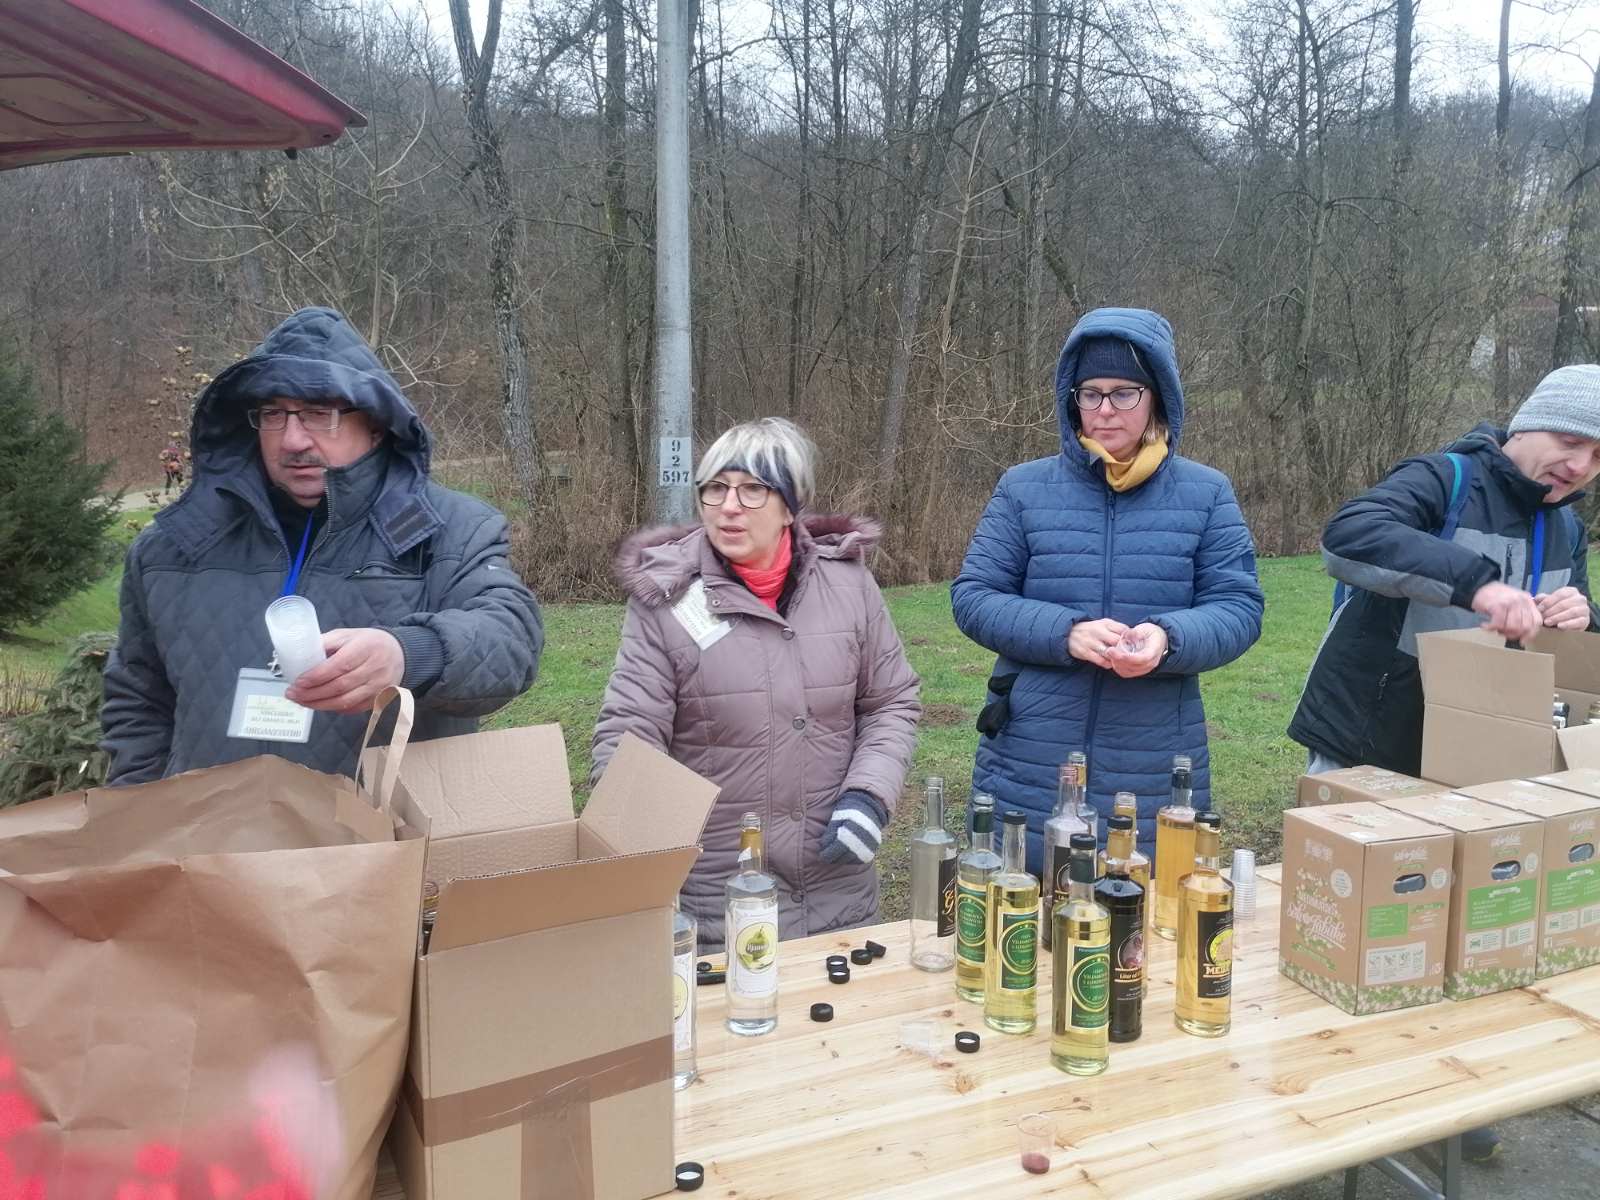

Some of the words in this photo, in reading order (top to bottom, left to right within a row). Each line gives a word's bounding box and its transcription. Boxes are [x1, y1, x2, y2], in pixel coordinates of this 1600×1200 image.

[671, 439, 681, 452] 9
[671, 455, 681, 467] 2
[662, 470, 689, 483] 597
